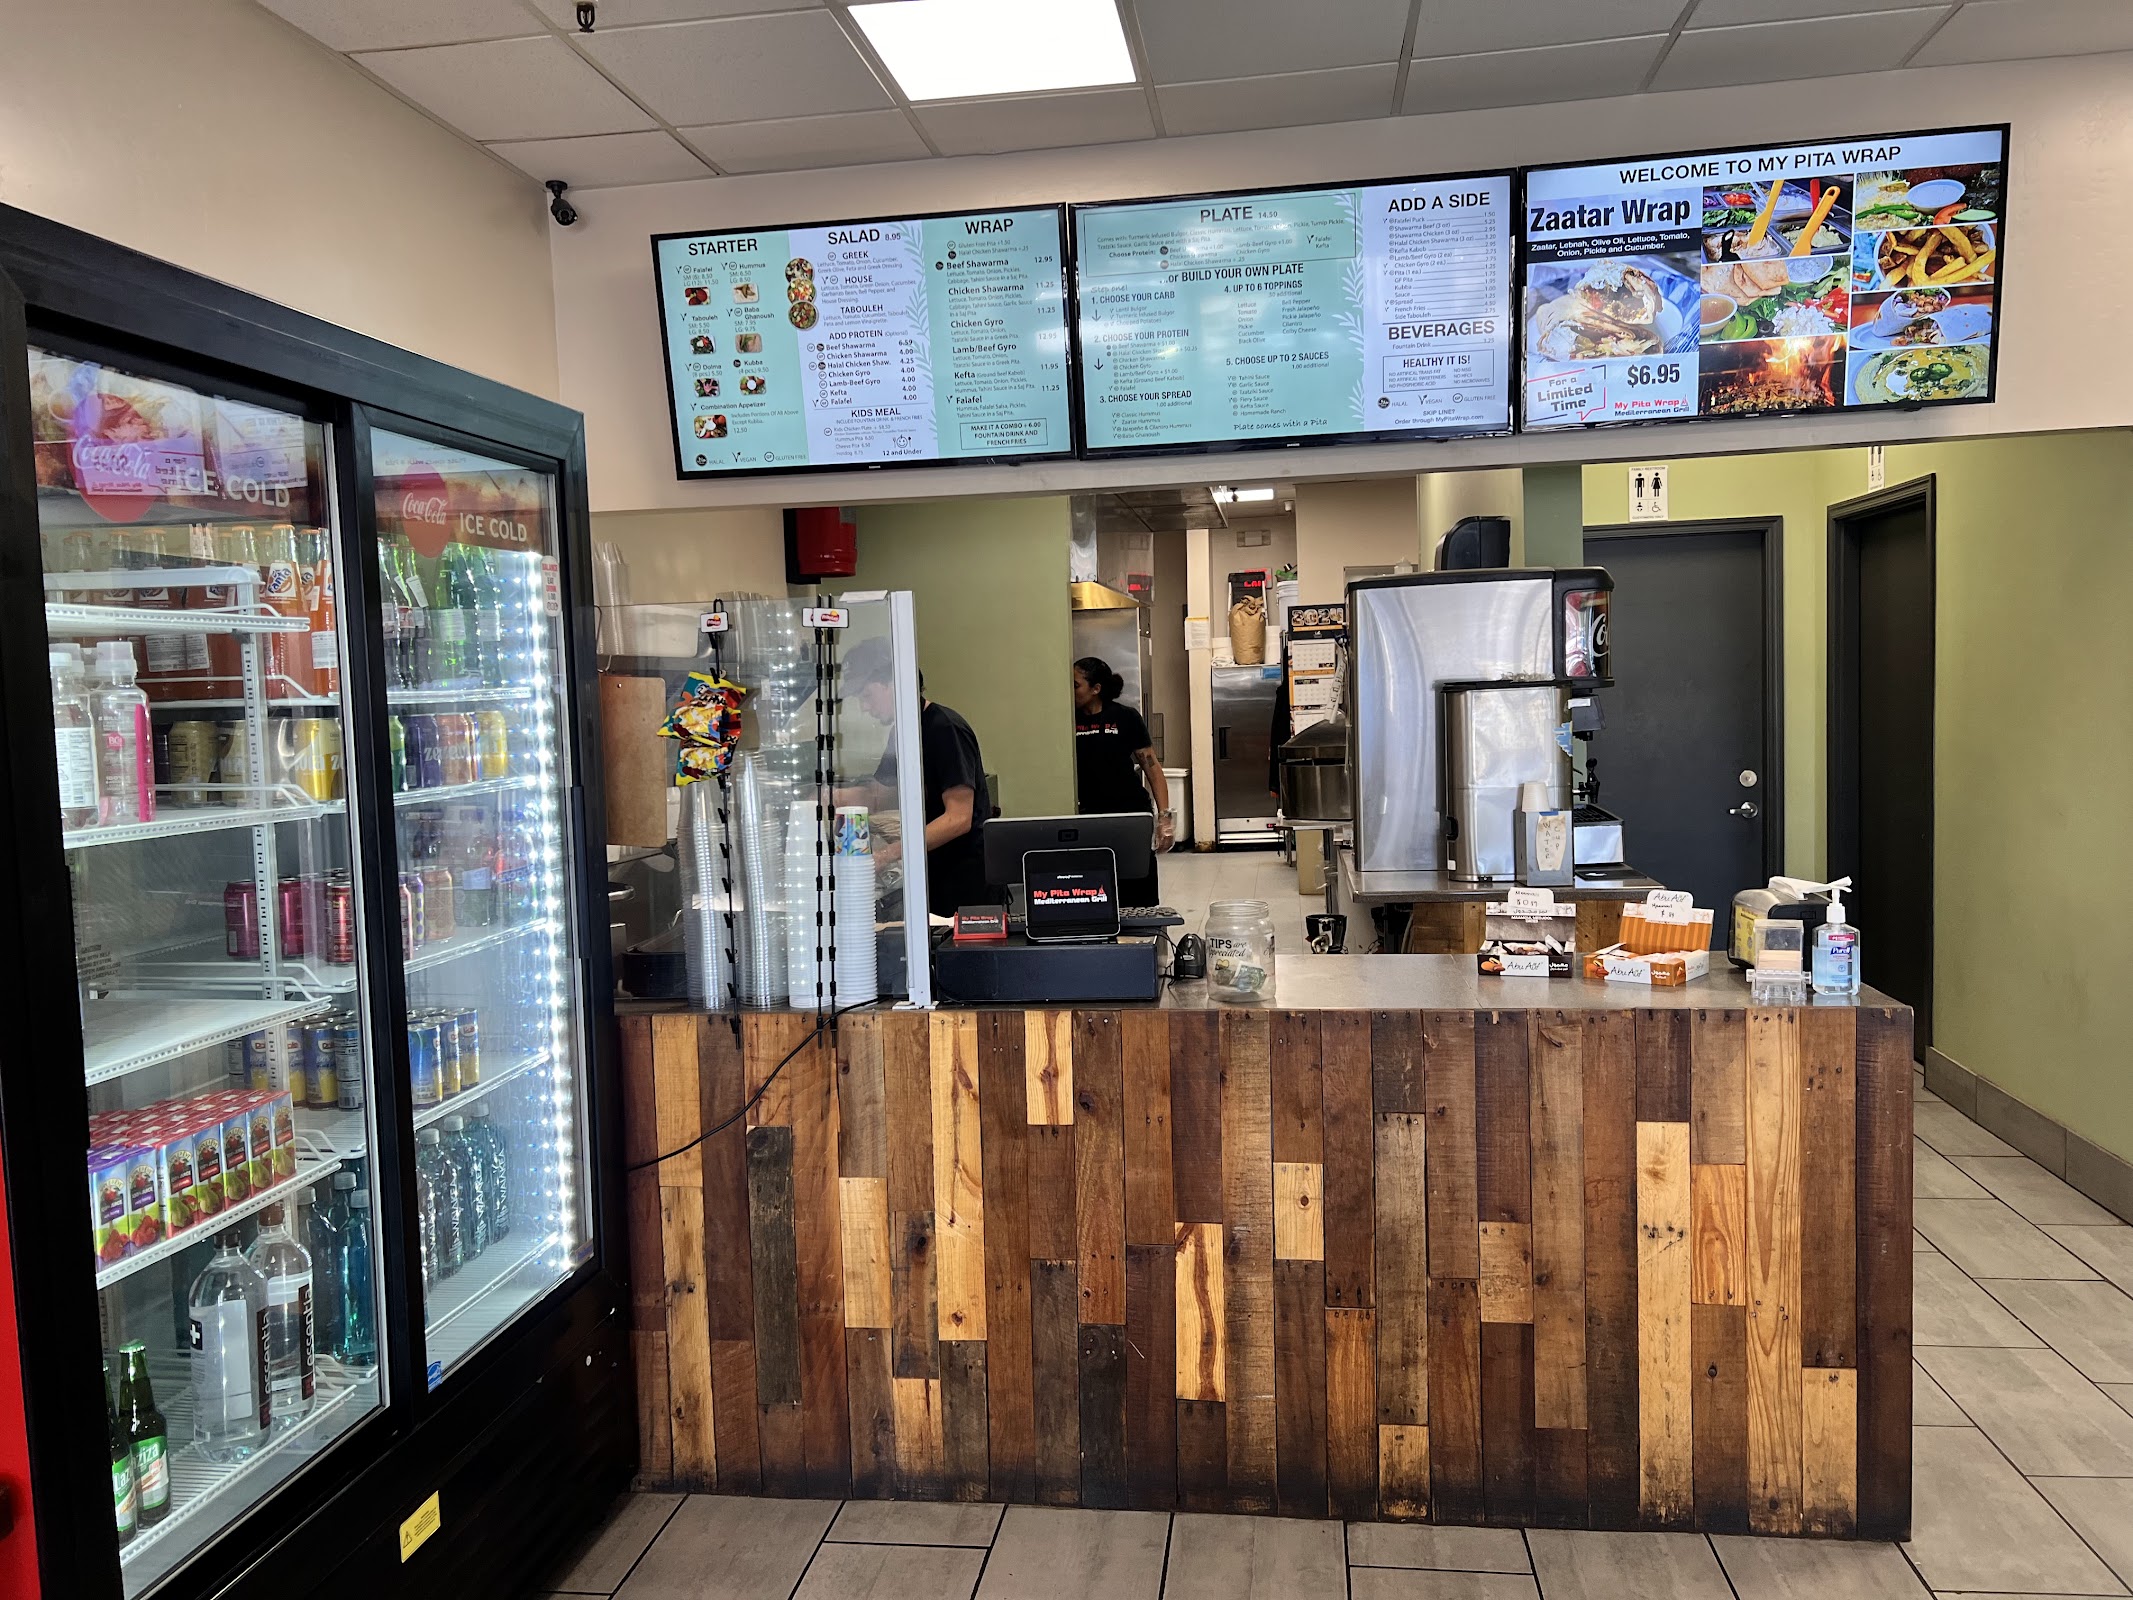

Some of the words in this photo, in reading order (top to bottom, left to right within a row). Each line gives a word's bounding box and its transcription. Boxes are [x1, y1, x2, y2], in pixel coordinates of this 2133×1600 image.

[1619, 162, 1719, 184] WELCOME
[1728, 159, 1752, 174] TO
[1758, 156, 1788, 172] MY
[1794, 152, 1836, 169] PITA
[1842, 146, 1901, 164] WRAP
[1388, 197, 1426, 213] ADD
[1432, 195, 1443, 210] A
[1449, 192, 1490, 208] SIDE
[1200, 206, 1252, 223] PLATE
[1530, 203, 1614, 233] Zaatar
[1621, 197, 1691, 225] Wrap
[965, 218, 1013, 235] WRAP
[828, 229, 880, 245] SALAD
[885, 232, 901, 240] 8.95
[1591, 238, 1611, 246] Olive
[1613, 235, 1625, 245] Oil,
[1627, 235, 1658, 244] Lettuce,
[1660, 232, 1690, 240] Tomato,
[688, 238, 758, 256] STARTER
[1557, 249, 1582, 257] Onion,
[1584, 247, 1606, 255] Pickle
[1624, 242, 1665, 252] Cucumber.
[843, 251, 868, 260] GREEK
[967, 259, 1008, 268] Shawarma
[1182, 270, 1211, 282] BUILD
[1215, 268, 1242, 280] YOUR
[1246, 265, 1268, 277] OWN
[1273, 263, 1304, 275] PLATE
[845, 275, 873, 284] HOUSE
[948, 287, 980, 295] Chicken
[982, 284, 1024, 293] Shawarma
[1233, 284, 1243, 293] UP
[1245, 284, 1255, 292] TO
[1258, 283, 1262, 291] 6
[1264, 280, 1303, 290] TOPPINGS
[1091, 297, 1098, 305] 1.
[1100, 294, 1129, 304] CHOOSE
[1132, 292, 1152, 302] YOUR
[1154, 291, 1175, 300] CARB
[840, 304, 883, 314] TABOULEH
[951, 319, 982, 328] Chicken
[985, 319, 1003, 327] Gyro
[1388, 320, 1495, 340] BEVERAGES
[830, 332, 846, 340] ADD
[849, 330, 882, 339] PROTEIN
[1094, 335, 1101, 343] 2.
[1103, 332, 1132, 343] CHOOSE
[1134, 331, 1154, 340] YOUR
[1157, 329, 1189, 338] PROTEIN
[953, 345, 995, 354] Lamb/Beef
[998, 343, 1016, 352] Gyro
[1226, 358, 1233, 366] 5.
[1235, 356, 1265, 365] CHOOSE
[1268, 355, 1277, 363] UP
[1280, 354, 1290, 362] TO
[1292, 353, 1296, 362] 2
[1299, 351, 1329, 361] SAUCES
[1403, 357, 1443, 368] HEALTHY
[1447, 356, 1455, 366] IT
[1459, 355, 1470, 365] IS!
[855, 370, 870, 378] Gyro
[954, 371, 975, 379] Kefta
[1627, 363, 1680, 388] $6.95
[1549, 379, 1569, 387] For
[1099, 395, 1106, 403] 3.
[1108, 394, 1138, 403] CHOOSE
[1140, 392, 1159, 401] YOUR
[1162, 390, 1191, 399] SPREAD
[1538, 383, 1593, 402] Limited
[956, 396, 982, 404] Falafel
[1551, 399, 1586, 412] Time
[1615, 402, 1627, 410] My
[1632, 400, 1650, 408] Pita
[1654, 399, 1680, 408] Wrap
[701, 403, 737, 411] Combination
[851, 409, 873, 418] KIDS
[875, 407, 900, 416] MEAL
[1615, 408, 1671, 417] Mediterranean
[975, 431, 1004, 439] FOUNTAIN
[226, 475, 290, 508] COLD
[402, 492, 448, 526] Coca-Cola
[460, 512, 485, 536] ICE
[489, 518, 527, 542] COLD
[266, 567, 292, 594] Fanta
[1034, 890, 1047, 899] My
[1050, 889, 1070, 897] Pita
[1072, 888, 1097, 897] Wrap
[1034, 897, 1090, 905] Mediterranean
[1092, 895, 1107, 903] Grill
[1210, 938, 1232, 949] TIPS
[303, 1287, 314, 1367] essentia
